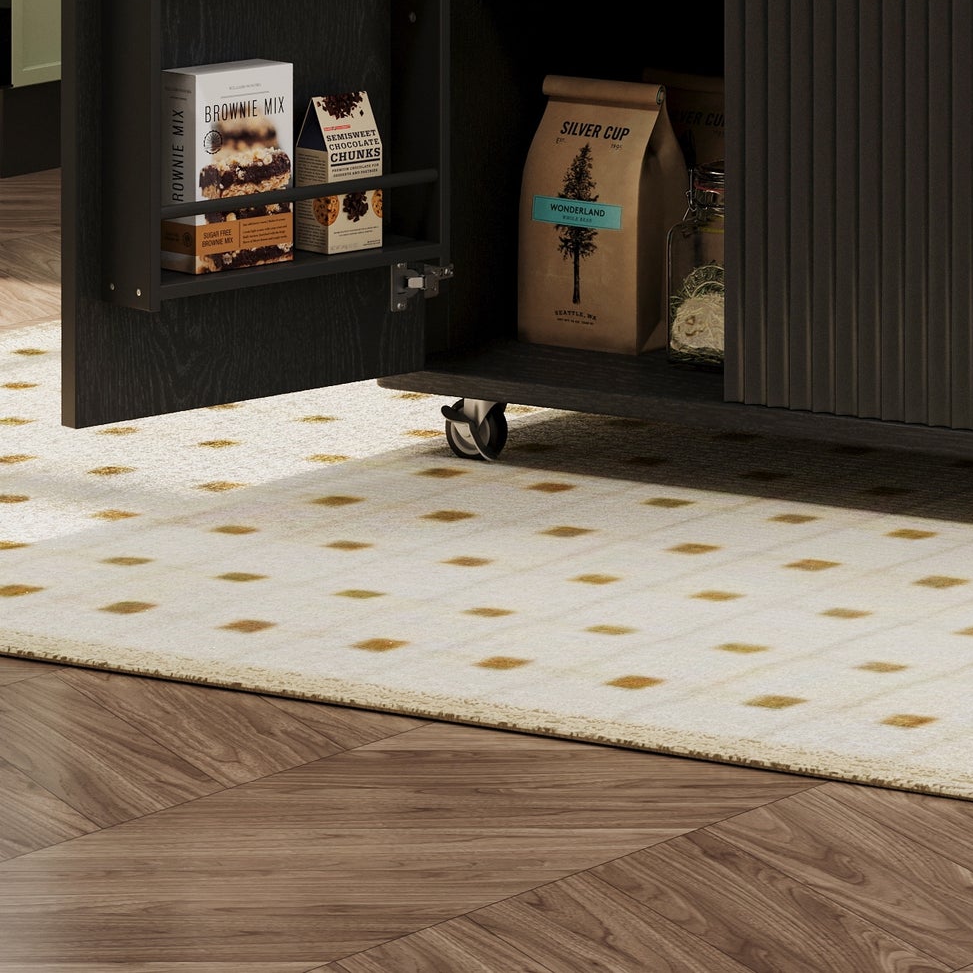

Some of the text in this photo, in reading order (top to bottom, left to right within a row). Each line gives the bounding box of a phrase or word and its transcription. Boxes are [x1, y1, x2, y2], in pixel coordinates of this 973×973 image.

[204, 96, 285, 123] BROWNIE MIX
[326, 129, 376, 142] SEMISWEET
[560, 121, 630, 141] SILVER CUP
[329, 138, 380, 151] CHOCOLATE
[172, 109, 184, 202] ROWNIE MIX
[330, 147, 381, 163] CHUNKS
[550, 203, 605, 217] WONDERLAND
[203, 228, 232, 239] SUGAR FREE
[202, 238, 223, 247] BROWNIE
